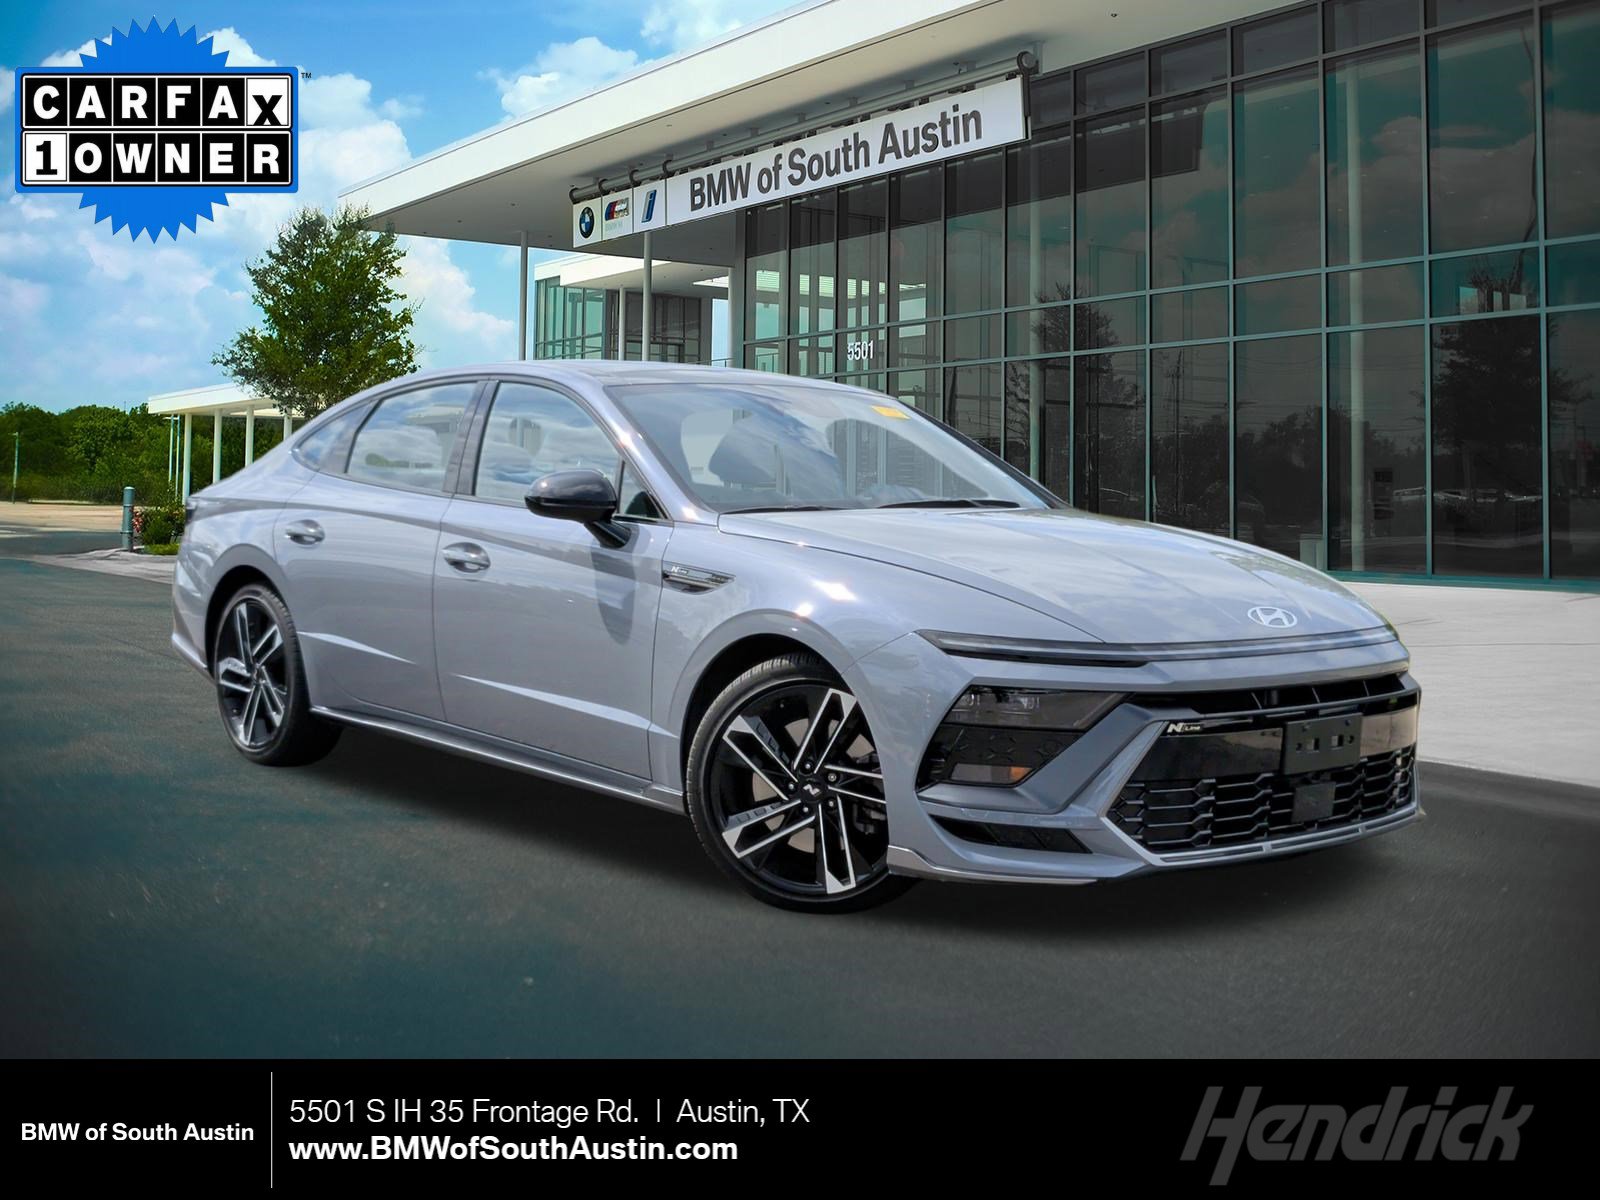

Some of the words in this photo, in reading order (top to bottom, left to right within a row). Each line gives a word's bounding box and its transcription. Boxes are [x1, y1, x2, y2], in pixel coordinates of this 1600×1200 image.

[690, 162, 752, 212] BMW
[757, 153, 783, 194] of
[787, 131, 871, 187] South
[878, 103, 982, 165] Austin
[847, 340, 874, 361] 5501
